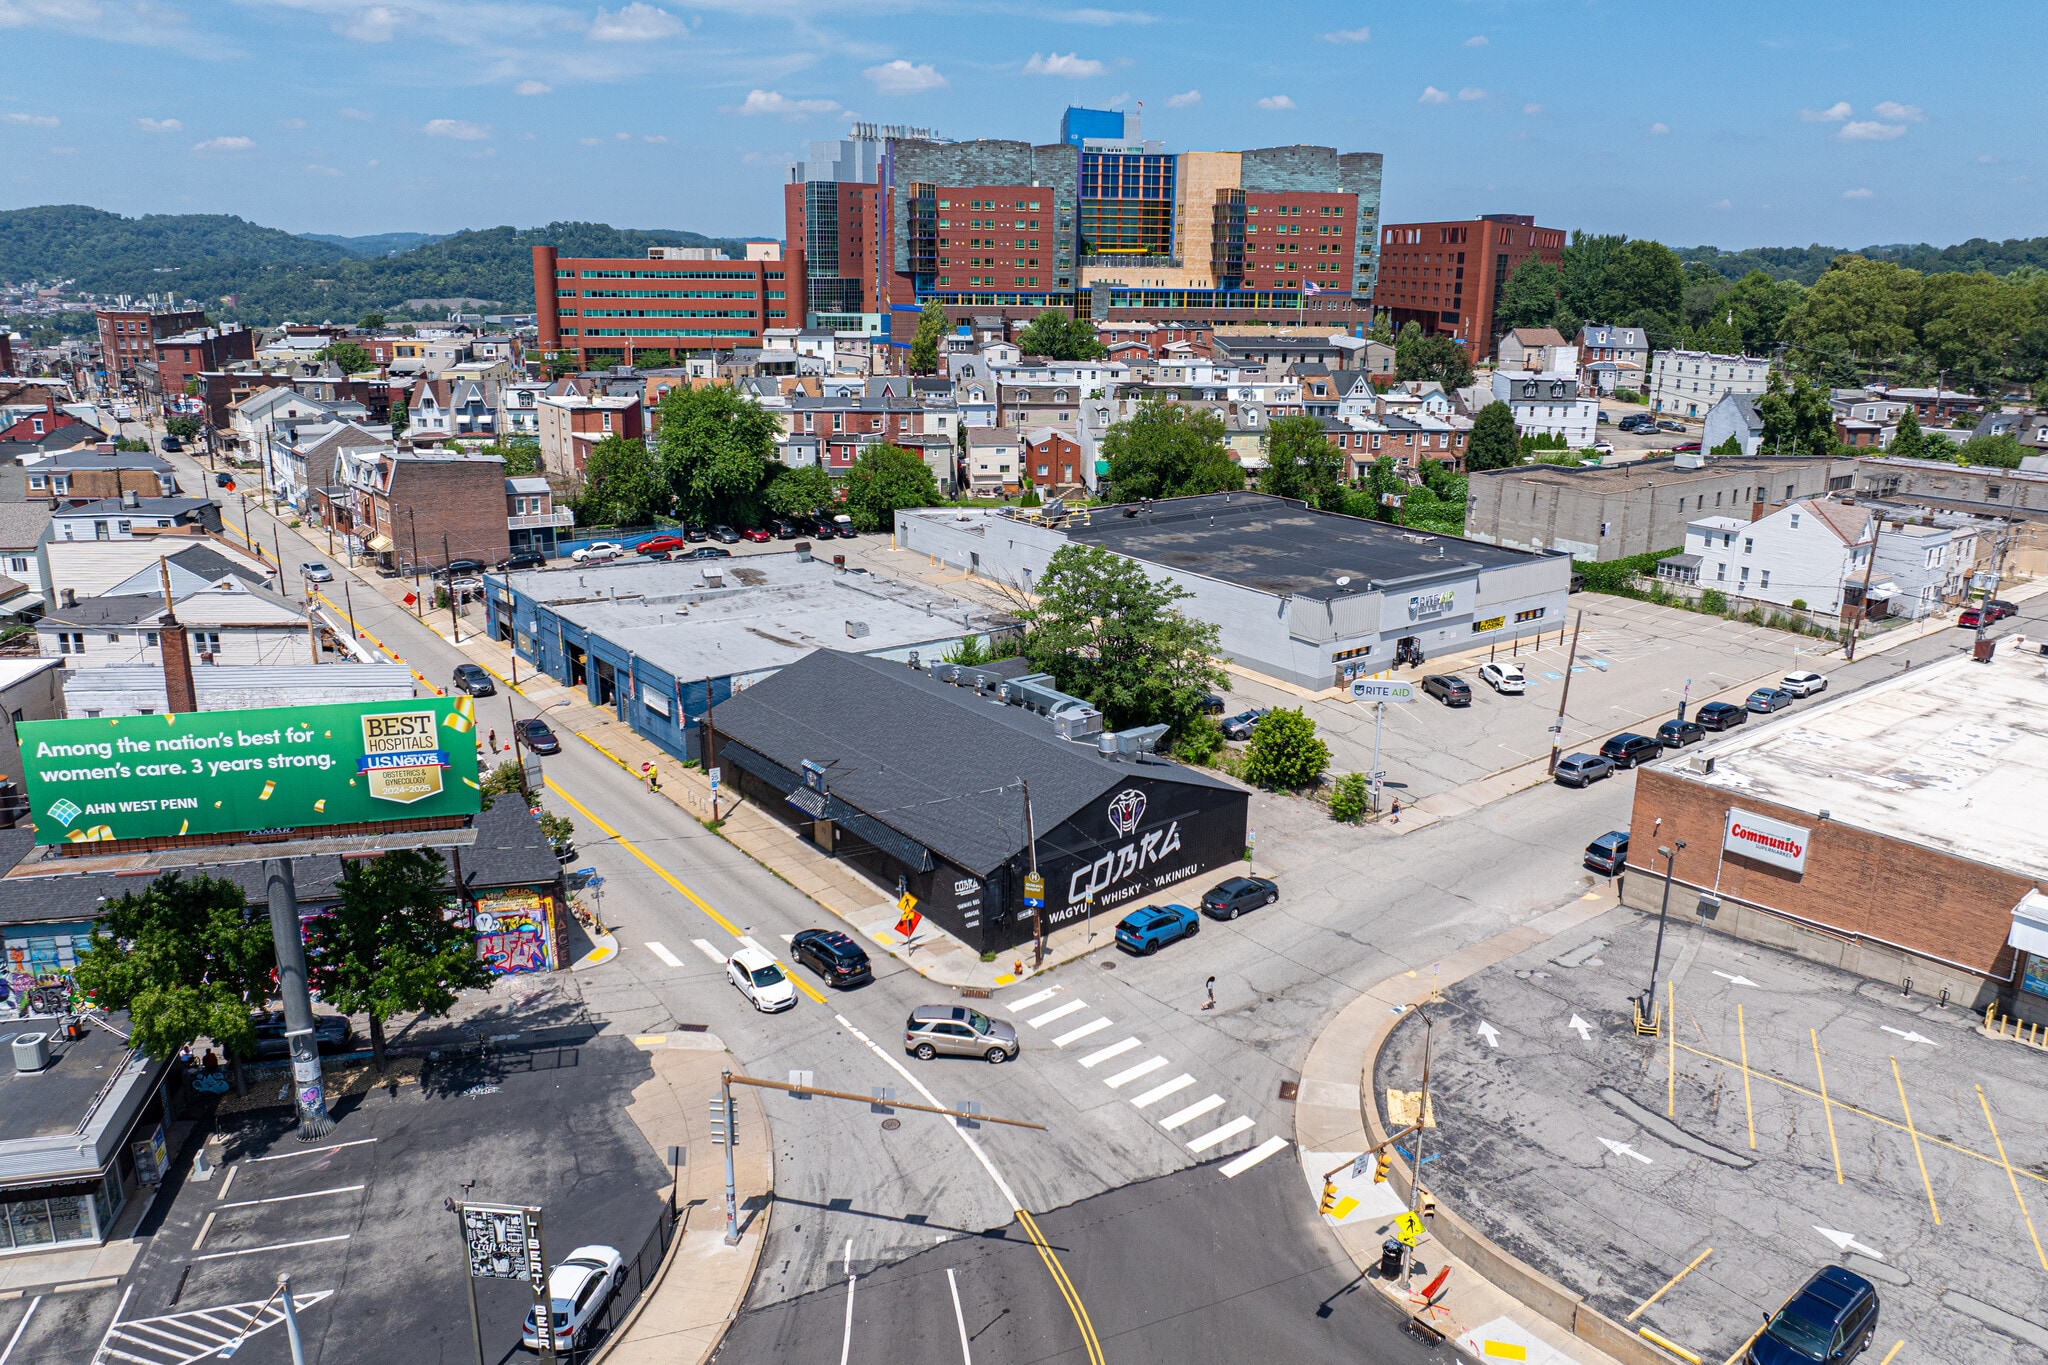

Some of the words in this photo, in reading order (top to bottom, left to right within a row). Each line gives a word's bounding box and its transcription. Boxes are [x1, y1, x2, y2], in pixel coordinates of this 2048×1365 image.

[1439, 591, 1455, 603] AID
[1480, 620, 1504, 631] CLOSING
[1366, 686, 1390, 696] RITE
[1391, 688, 1410, 697] AID
[367, 716, 430, 737] BEST
[36, 741, 112, 759] Among
[117, 737, 150, 754] the
[155, 732, 233, 752] nation's
[237, 729, 281, 747] best
[284, 727, 315, 745] for
[369, 736, 433, 752] HOSPITALS
[39, 762, 131, 783] women's
[135, 761, 187, 778] care.
[191, 758, 203, 774] 3
[207, 758, 264, 777] years
[267, 752, 337, 771] strong.
[383, 769, 421, 779] OBSTETRICS
[382, 784, 431, 795] 2024-2025
[385, 777, 426, 787] GYNECOLOGY
[85, 802, 116, 816] AHN
[118, 799, 158, 814] WEST
[160, 797, 198, 811] PENN
[1731, 823, 1803, 859] Community
[1755, 844, 1792, 859] SUPERMARKET
[1068, 820, 1181, 904] COBRA
[954, 878, 979, 892] COBRA
[1048, 902, 1088, 924] WAGYU
[1101, 883, 1142, 906] WHISKY
[1153, 863, 1198, 887] YAKINIKU
[471, 1240, 498, 1254] Craft
[498, 1242, 523, 1253] Beer
[526, 1215, 545, 1296] LIBERTY
[534, 1304, 551, 1350] BEER
